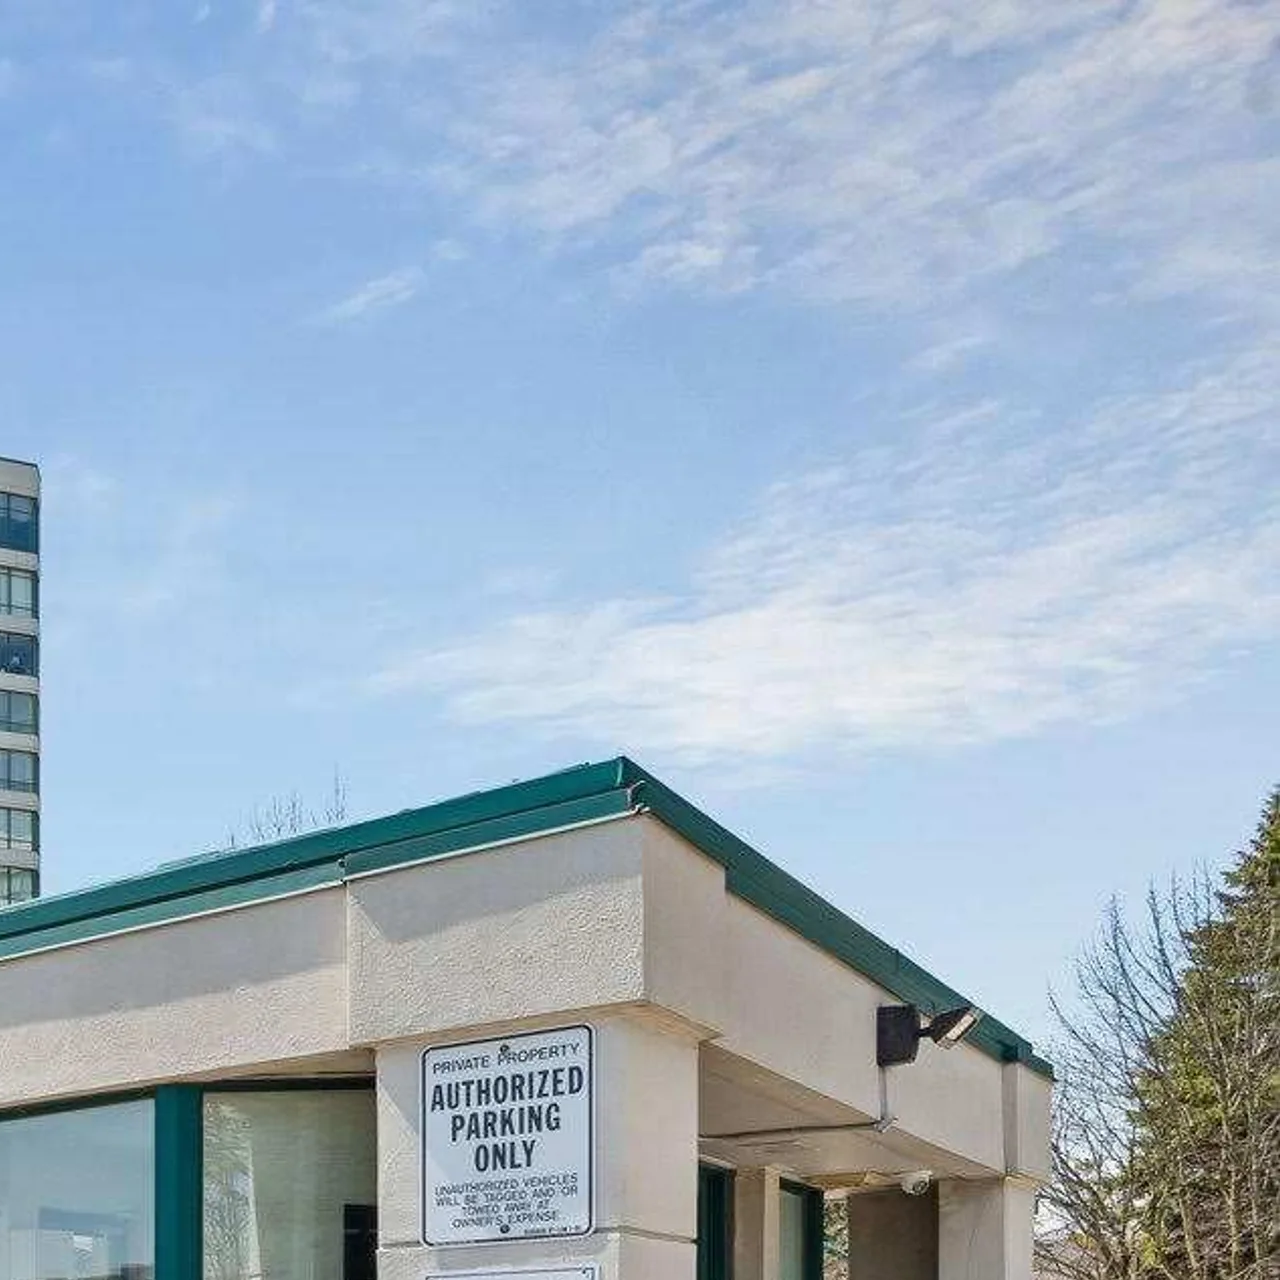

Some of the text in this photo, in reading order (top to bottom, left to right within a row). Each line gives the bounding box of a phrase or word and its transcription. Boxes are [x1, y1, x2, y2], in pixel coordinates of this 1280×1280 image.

[432, 1043, 581, 1074] PRIVATE PROPERTY
[431, 1065, 584, 1112] AUTHORIZED
[451, 1103, 561, 1142] PARKING
[474, 1140, 536, 1172] ONLY
[434, 1178, 520, 1197] UNAUTHORIZED
[523, 1172, 579, 1188] VEHICLES
[435, 1196, 462, 1206] WILL
[461, 1205, 500, 1217] TOWED
[508, 1211, 558, 1225] EXPENSE
